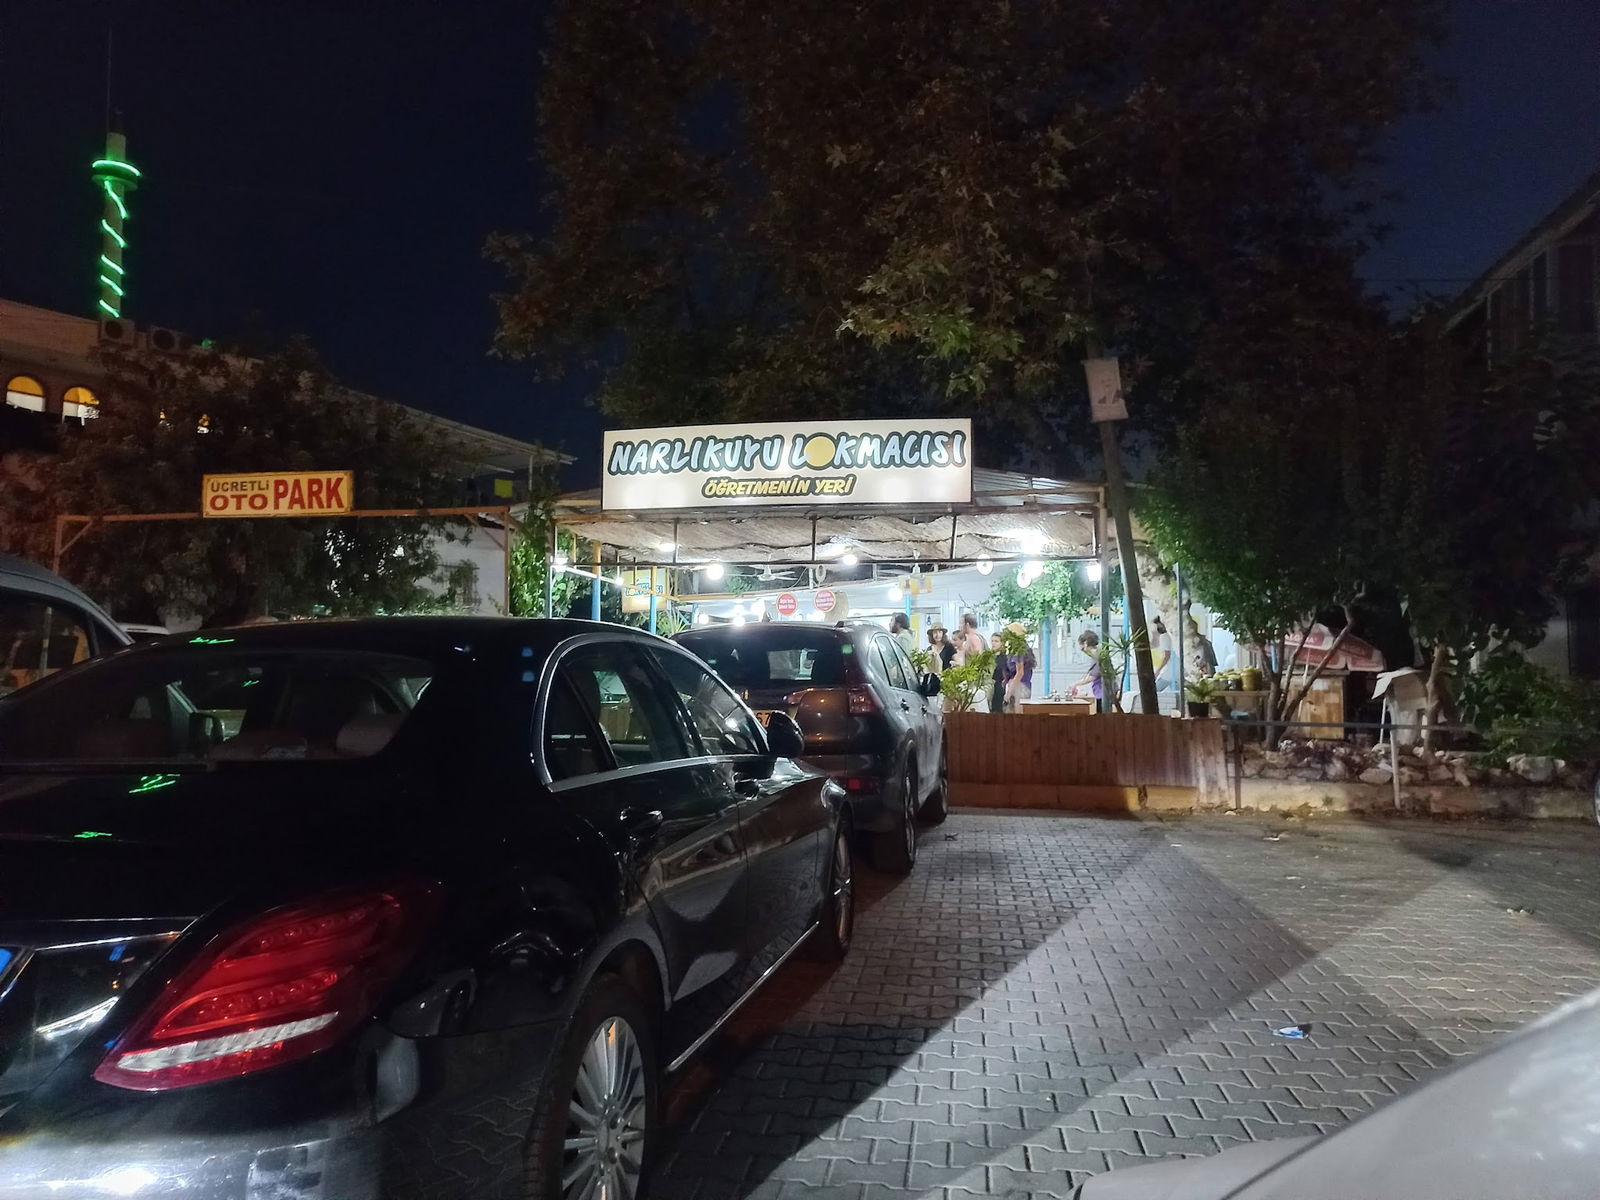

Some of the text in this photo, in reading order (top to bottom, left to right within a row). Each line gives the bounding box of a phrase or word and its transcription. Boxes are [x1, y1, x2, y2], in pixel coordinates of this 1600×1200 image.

[609, 436, 783, 474] NARLIKUYU
[209, 477, 345, 511] OTO PARK
[704, 475, 854, 496] ÖĞRETMENİN YERİ
